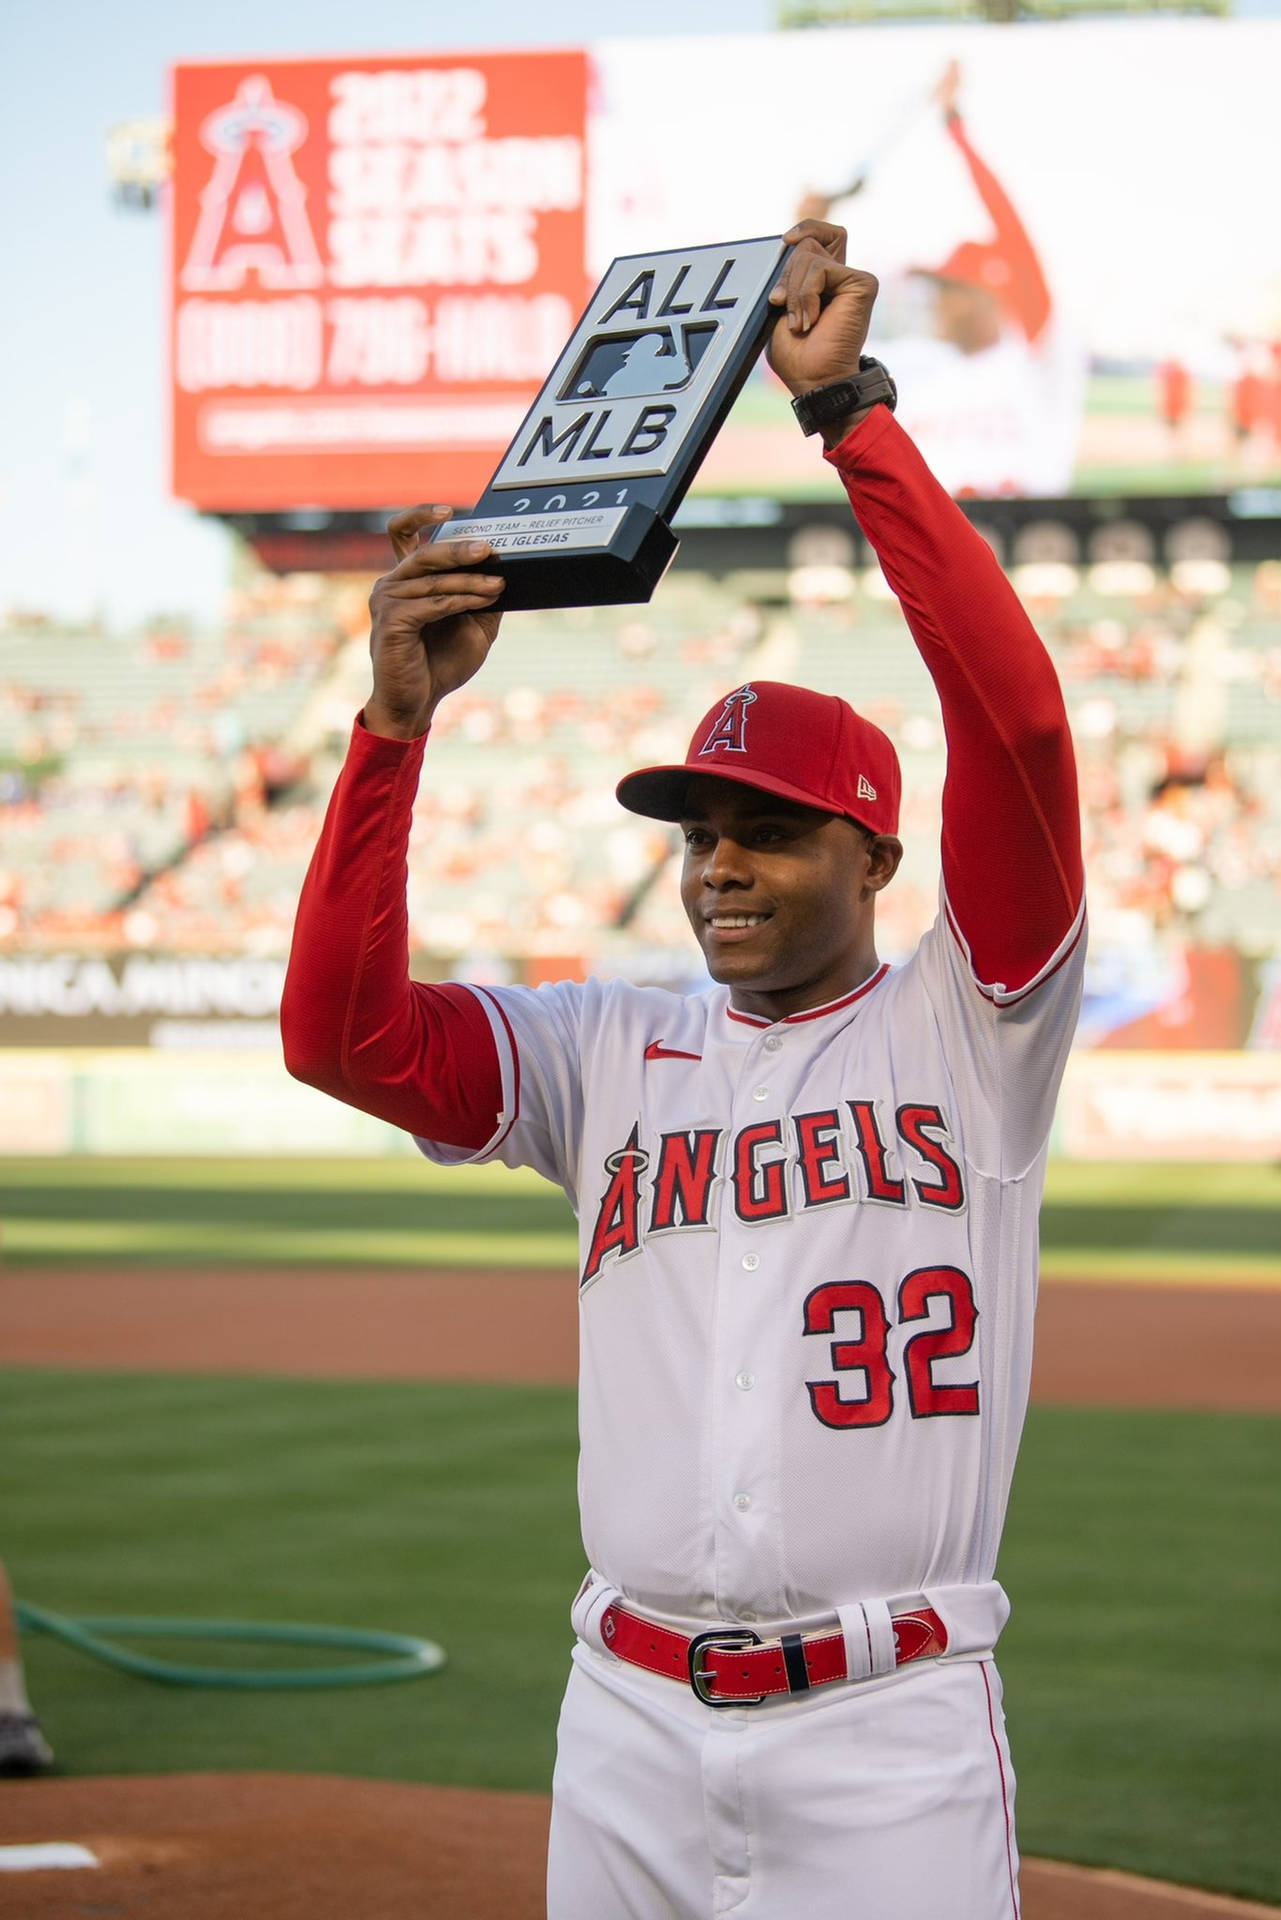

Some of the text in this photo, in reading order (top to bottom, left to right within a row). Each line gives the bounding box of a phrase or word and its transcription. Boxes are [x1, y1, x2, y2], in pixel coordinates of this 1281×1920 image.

[597, 258, 740, 325] ALL
[516, 402, 678, 467] MLB
[452, 524, 493, 536] SECOND
[495, 521, 521, 532] TEAM
[529, 518, 561, 530] RELIEF
[562, 514, 605, 527] PITCHER
[486, 532, 570, 549] SEL IGLESIAS
[698, 683, 758, 756] A
[579, 1099, 968, 1300] ANGELS
[803, 1264, 980, 1430] 32
